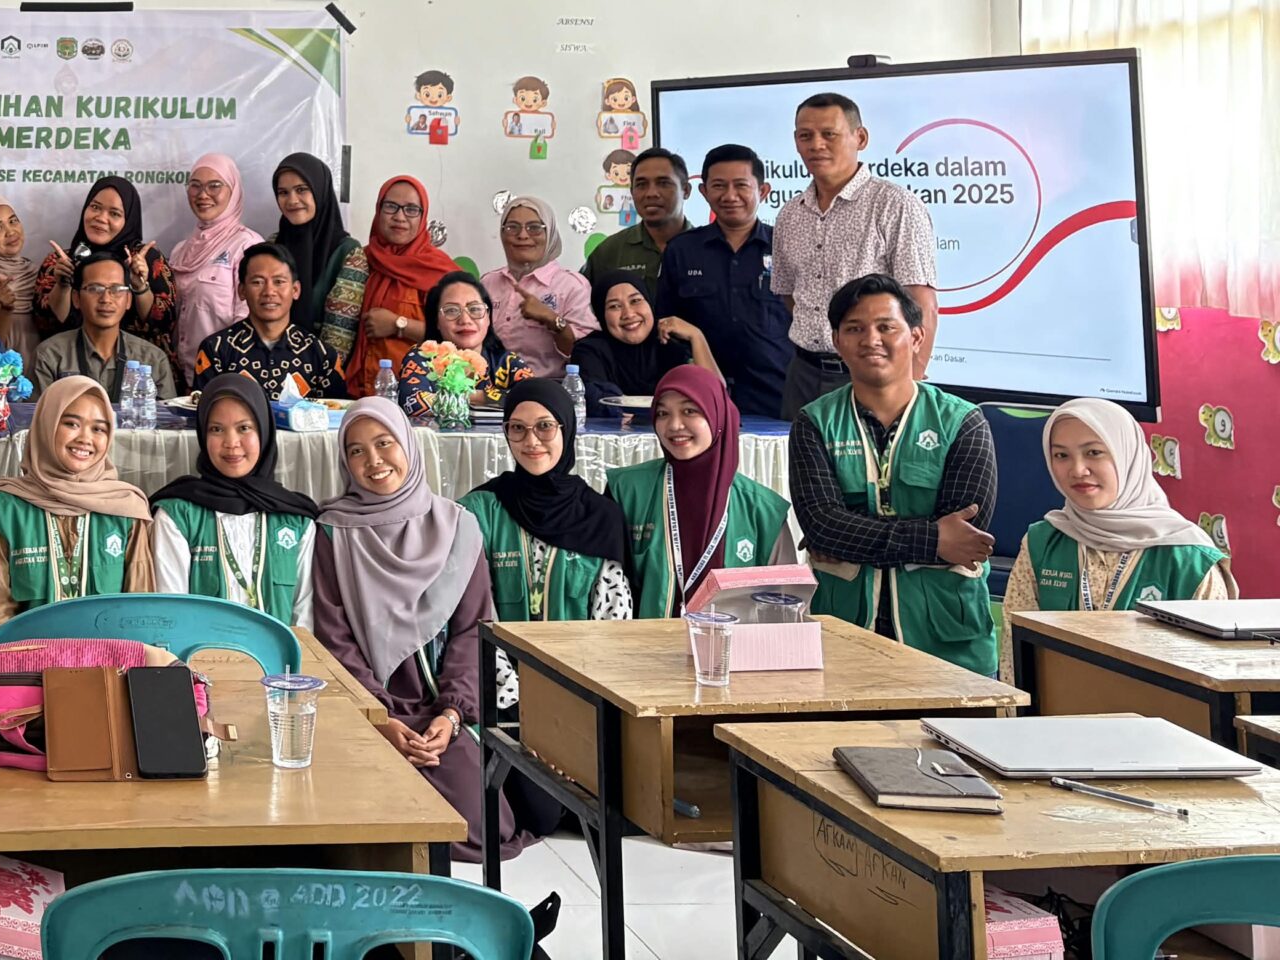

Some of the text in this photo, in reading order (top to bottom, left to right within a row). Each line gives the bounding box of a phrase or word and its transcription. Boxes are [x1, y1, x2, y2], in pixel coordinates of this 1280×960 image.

[76, 95, 237, 120] KURIKULUM
[765, 156, 1007, 179] ikulu rdeka dalam
[952, 183, 1014, 204] 2025
[936, 236, 960, 250] lam
[351, 883, 424, 911] 2022
